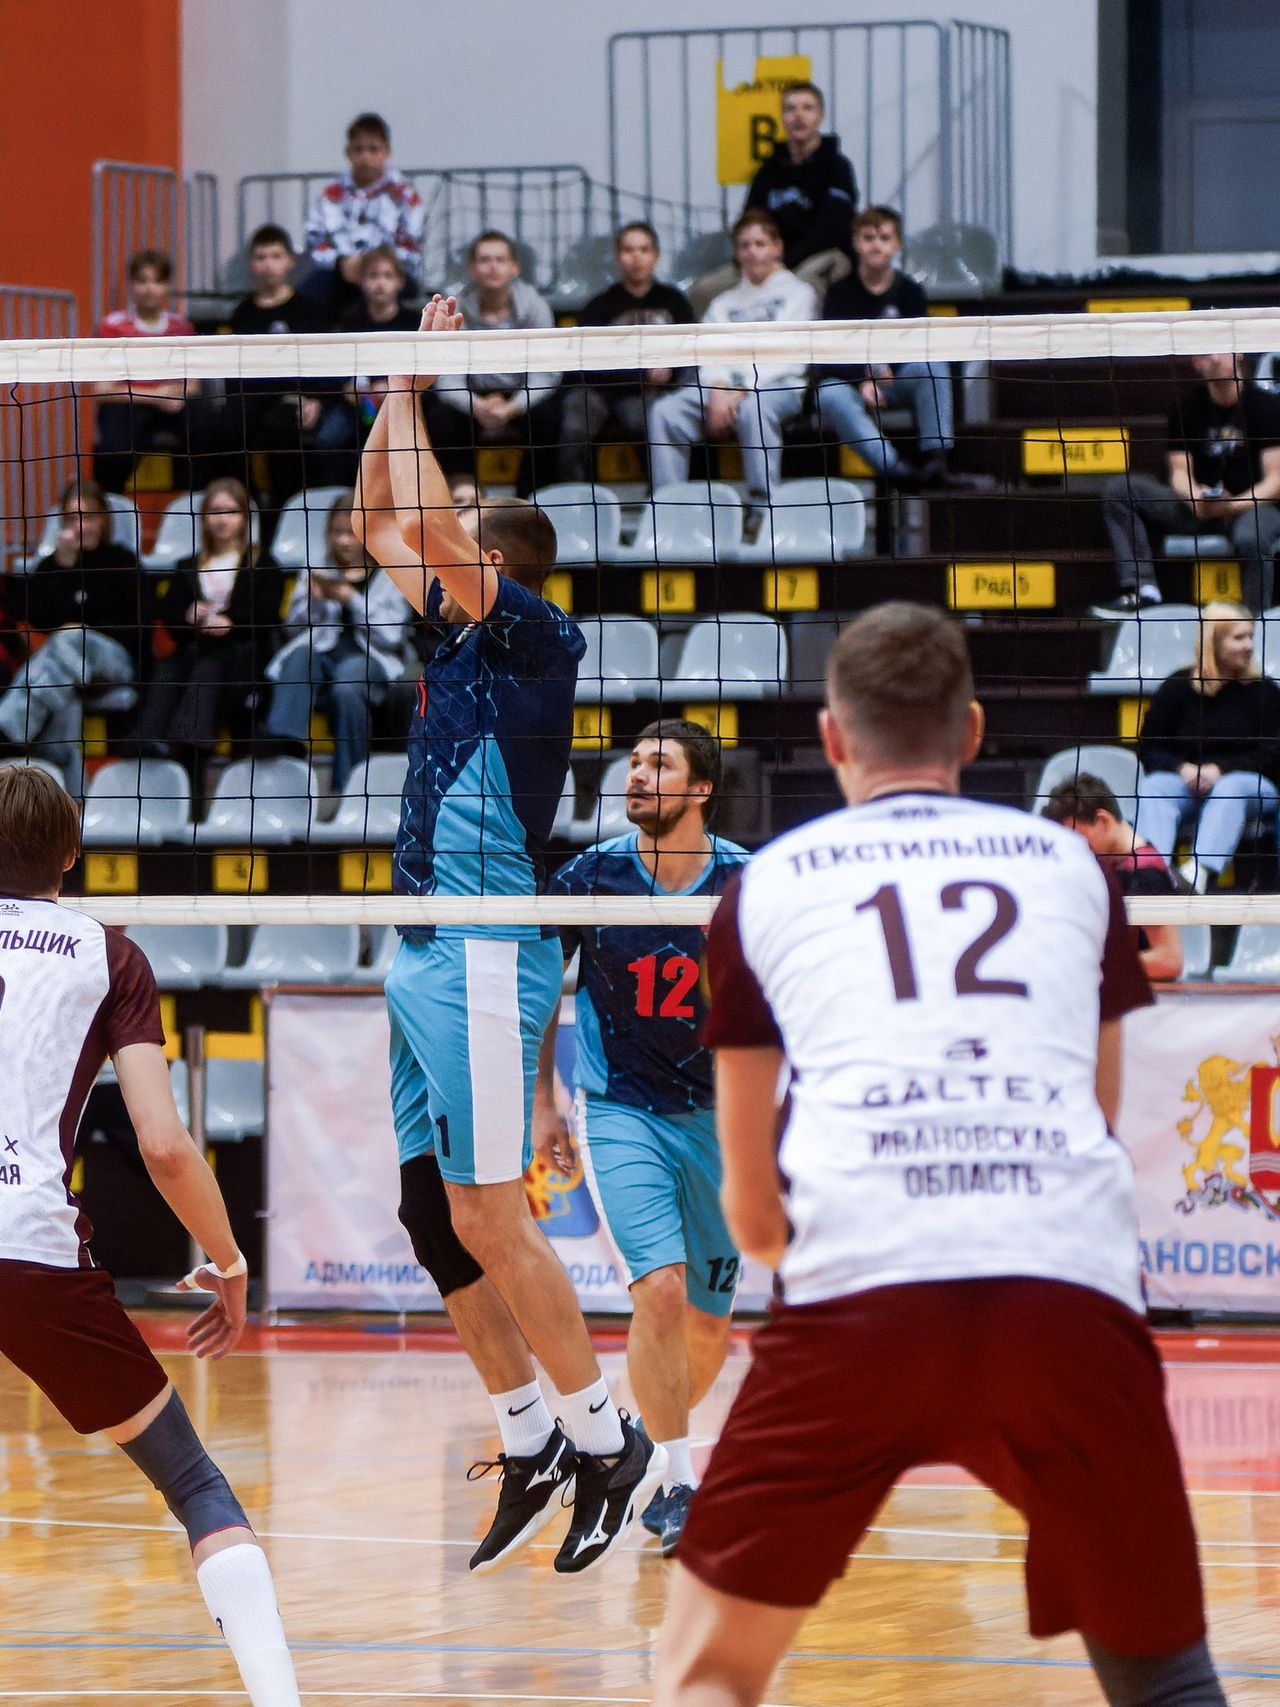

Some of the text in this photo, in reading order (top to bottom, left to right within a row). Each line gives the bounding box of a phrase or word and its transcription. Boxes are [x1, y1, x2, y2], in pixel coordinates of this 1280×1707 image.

[788, 833, 1063, 878] ТЕКСТИЛЬЩИК
[853, 878, 1031, 1003] 12
[627, 955, 701, 1018] 12
[862, 1074, 1066, 1108] GALTEX
[869, 1122, 1071, 1159] ИВАНОВСКАЯ
[904, 1161, 1043, 1199] ОБЛАСТЬ
[304, 1260, 427, 1286] АДМИНИС
[706, 1256, 740, 1293] 12
[1138, 1239, 1280, 1277] АНОВСК
